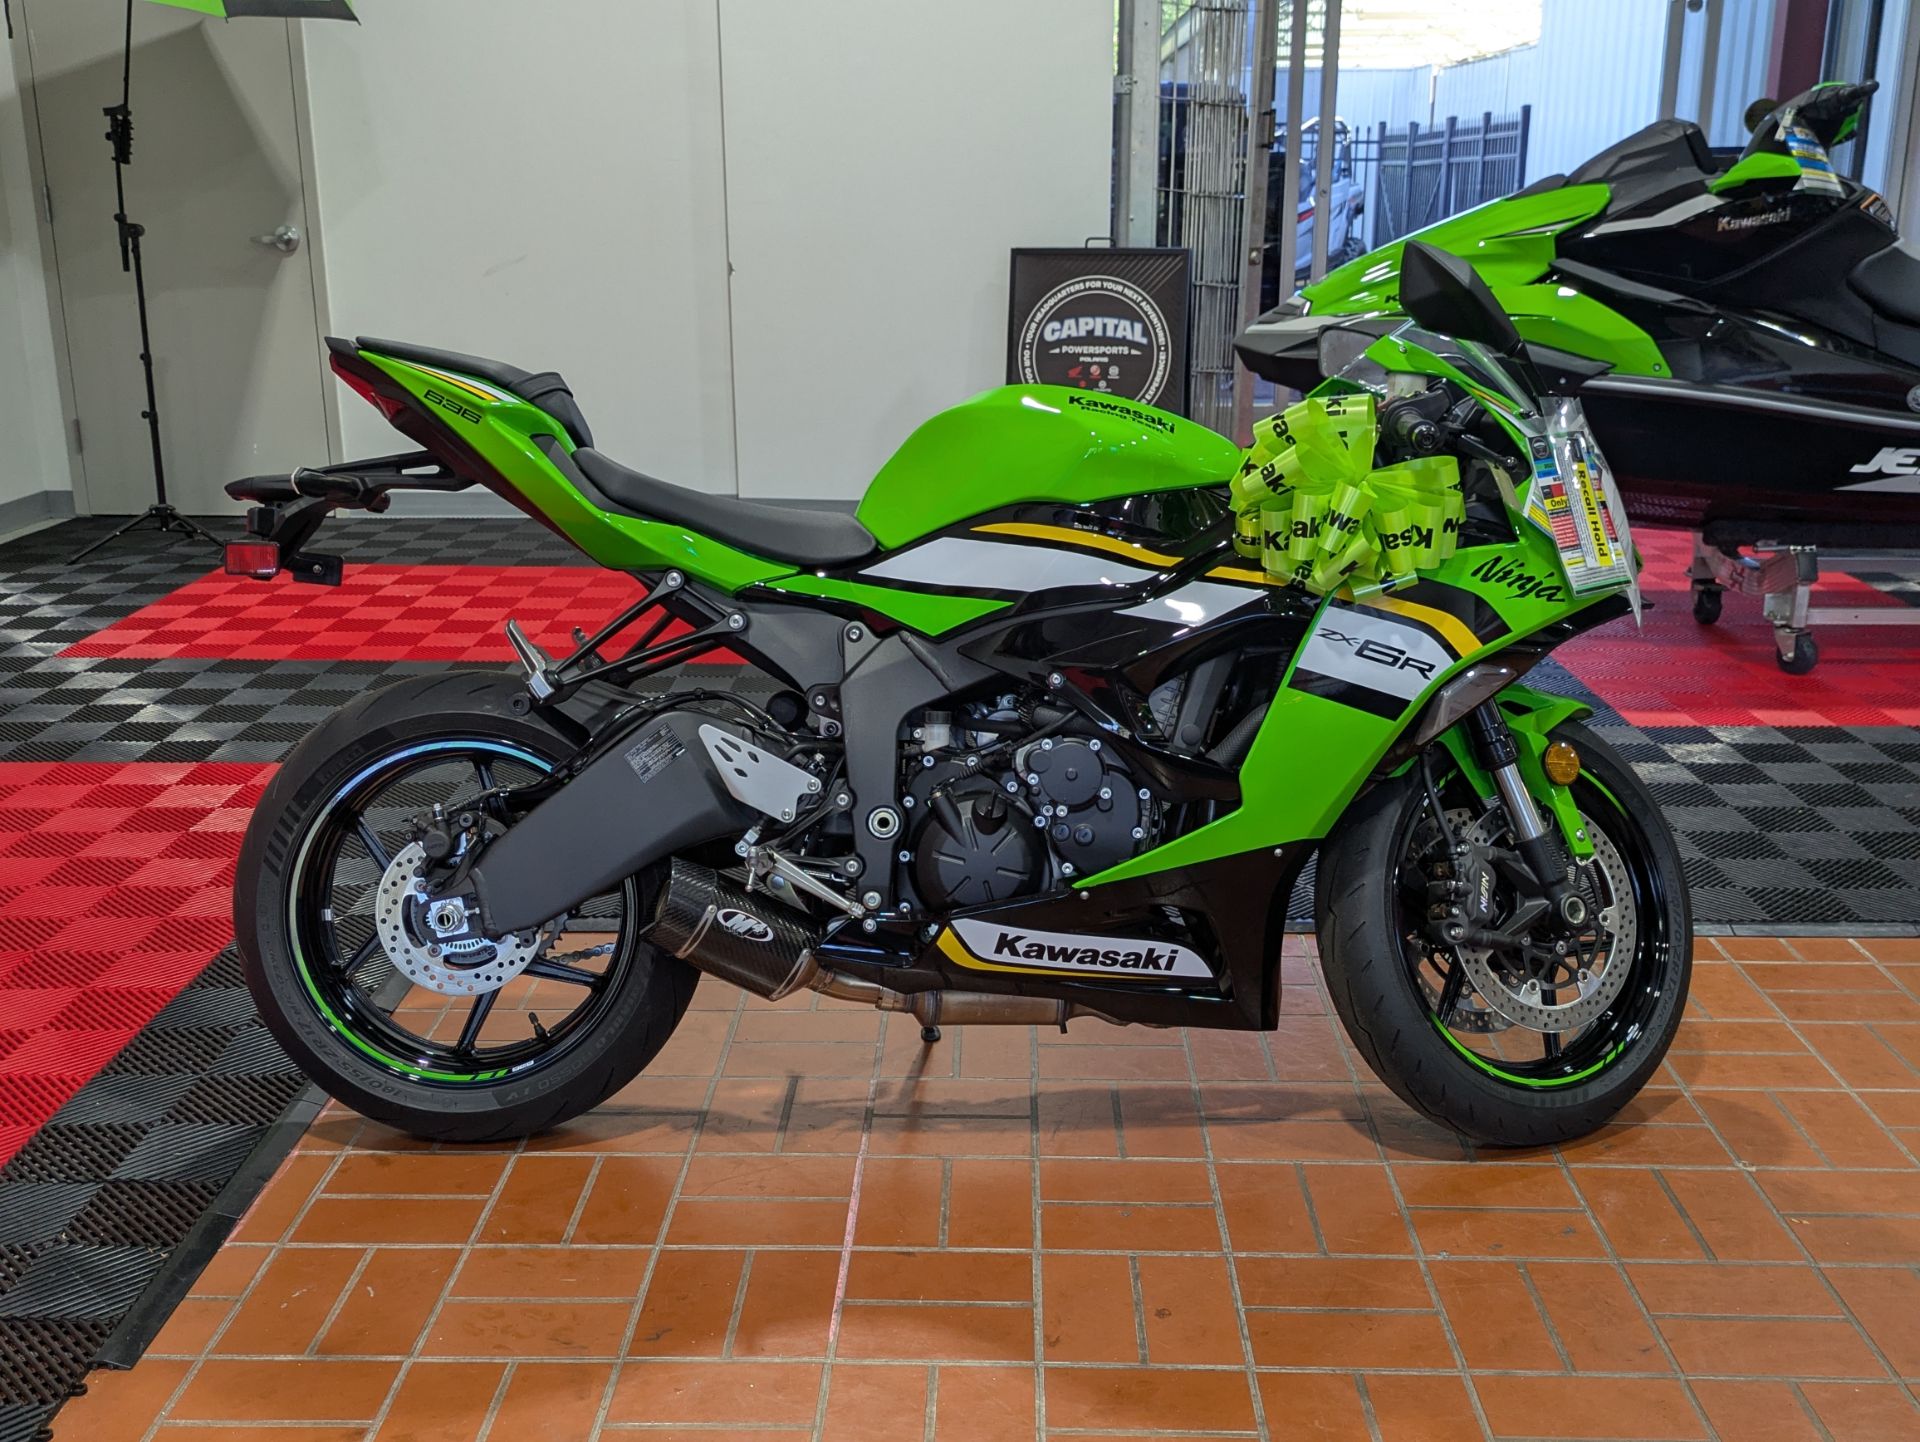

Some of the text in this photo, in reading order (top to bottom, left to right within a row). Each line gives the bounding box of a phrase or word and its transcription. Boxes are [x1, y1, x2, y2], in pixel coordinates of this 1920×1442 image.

[1717, 207, 1792, 232] Kawasaki
[1026, 322, 1037, 343] YOUR
[1036, 282, 1085, 323] HEADQUARTERS
[1086, 280, 1102, 289] FOR
[1103, 281, 1124, 293] YOUR
[1123, 287, 1143, 303] NEXT
[1043, 316, 1148, 345] CAPITAL
[1061, 345, 1129, 355] POWERSPORTS
[423, 388, 483, 425] 636
[1069, 395, 1175, 434] Kawasaki
[1080, 406, 1128, 420] Racing
[1849, 446, 1920, 475] JE
[1550, 498, 1568, 508] Only
[1577, 470, 1598, 517] Recall
[1591, 520, 1609, 558] Hold
[1471, 554, 1567, 604] Ninja
[1315, 626, 1437, 681] ZX-6R
[993, 931, 1180, 971] Kawasaki
